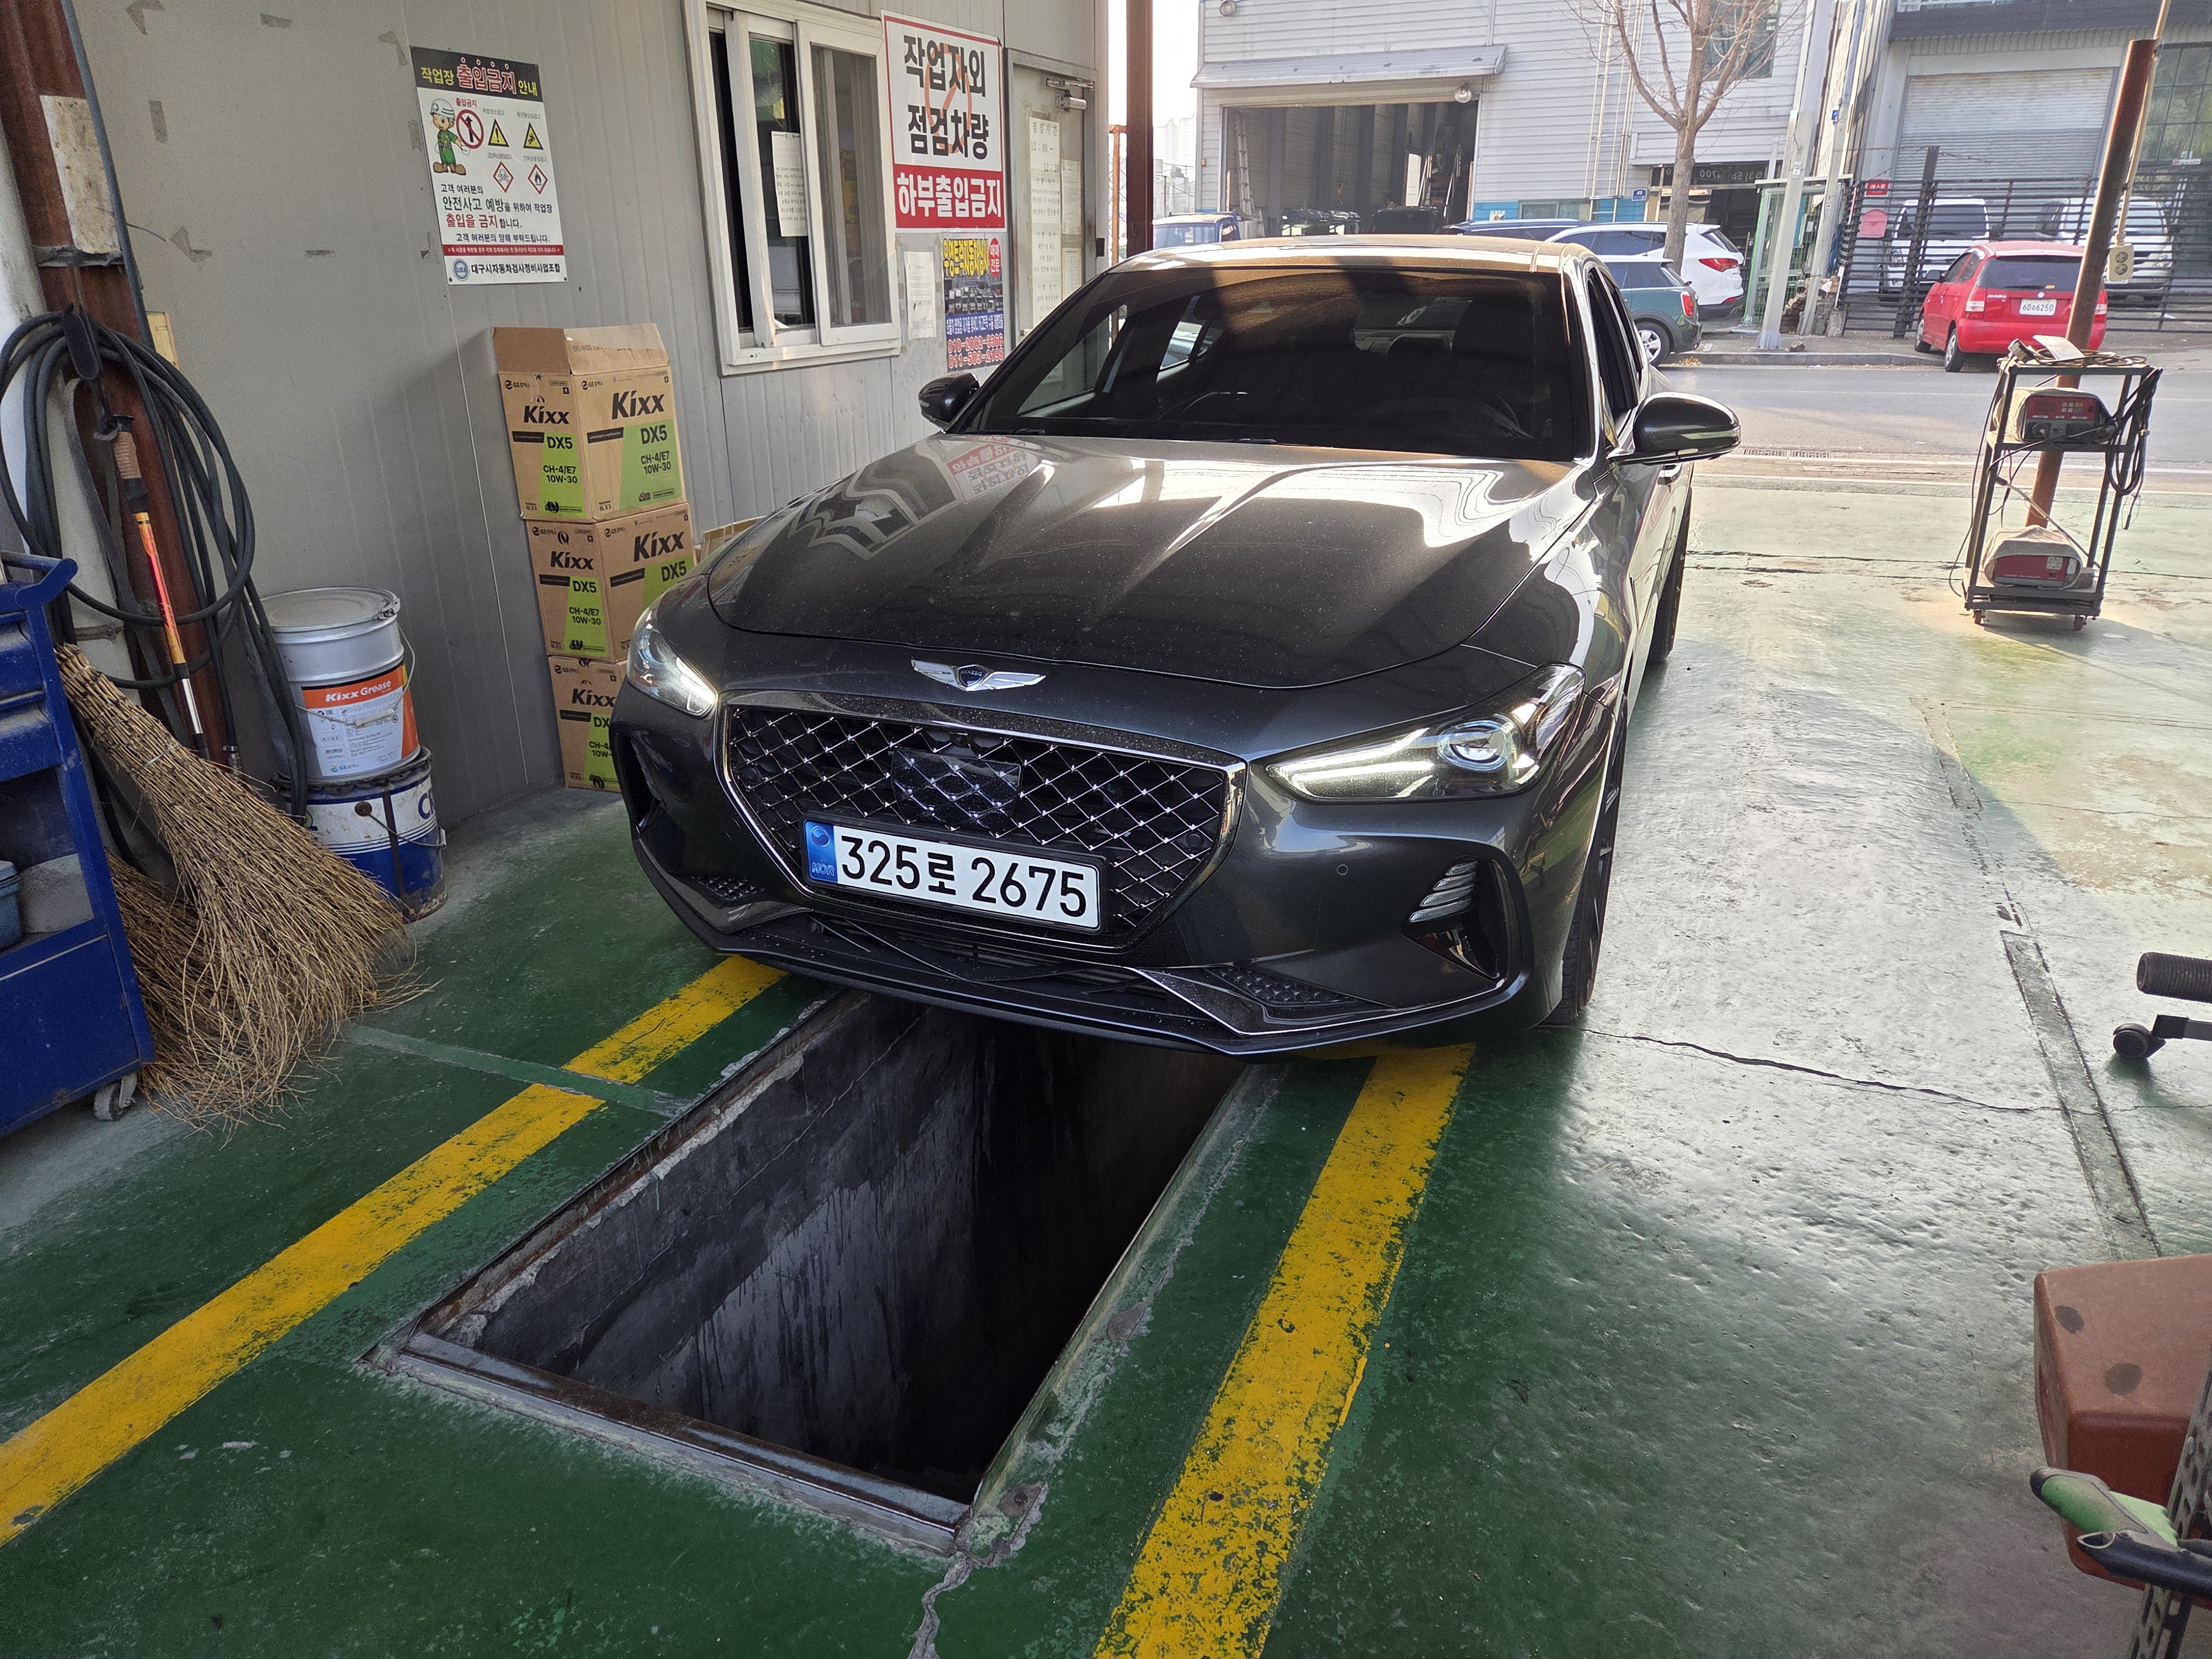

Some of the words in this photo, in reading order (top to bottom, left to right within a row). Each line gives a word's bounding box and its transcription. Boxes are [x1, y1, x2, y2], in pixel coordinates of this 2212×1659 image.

[904, 35, 985, 97] 작업자외
[421, 67, 454, 85] 작업장
[457, 63, 517, 94] 출입금지
[518, 80, 538, 96] 안내
[456, 97, 477, 108] 출입금지
[907, 105, 989, 159] 점검차량
[441, 184, 455, 194] 고객
[457, 185, 483, 195] 여러분의
[897, 172, 1001, 217] 하부출입금지
[443, 196, 483, 211] 안전사고
[486, 198, 510, 212] 예방을
[513, 203, 532, 213] 위하여
[534, 204, 552, 213] 작업장
[446, 213, 475, 228] 출입을
[478, 215, 498, 228] 금지
[499, 218, 522, 229] 합니다.
[456, 233, 469, 242] 고객
[472, 233, 497, 243] 여러분의
[499, 234, 511, 243] 양해
[513, 234, 550, 243] 부탁드립니다.
[947, 333, 1004, 354] 010-2002-3366
[948, 347, 1004, 369] 011-503-2198
[612, 390, 664, 420] Kixx
[523, 405, 570, 424] Kixx
[546, 436, 573, 450] DX5
[640, 425, 667, 445] DX5
[641, 451, 669, 464] CH-4/E7
[543, 465, 576, 474] CH-4/E7
[644, 461, 671, 474] 10W-30
[546, 474, 577, 483] 10W-30
[633, 531, 685, 562] Kixx
[550, 551, 594, 570] Kixx
[661, 560, 687, 582] DX5
[572, 581, 597, 593] DX5
[569, 607, 599, 616] CH-4/E7
[572, 616, 601, 625] 10W-30
[326, 691, 359, 702] Kixx
[360, 680, 391, 696] Grease
[572, 688, 616, 707] Kixx
[593, 716, 611, 728] DX
[812, 862, 835, 877] KOR
[841, 835, 957, 896] 325로
[971, 856, 1087, 917] 2675
